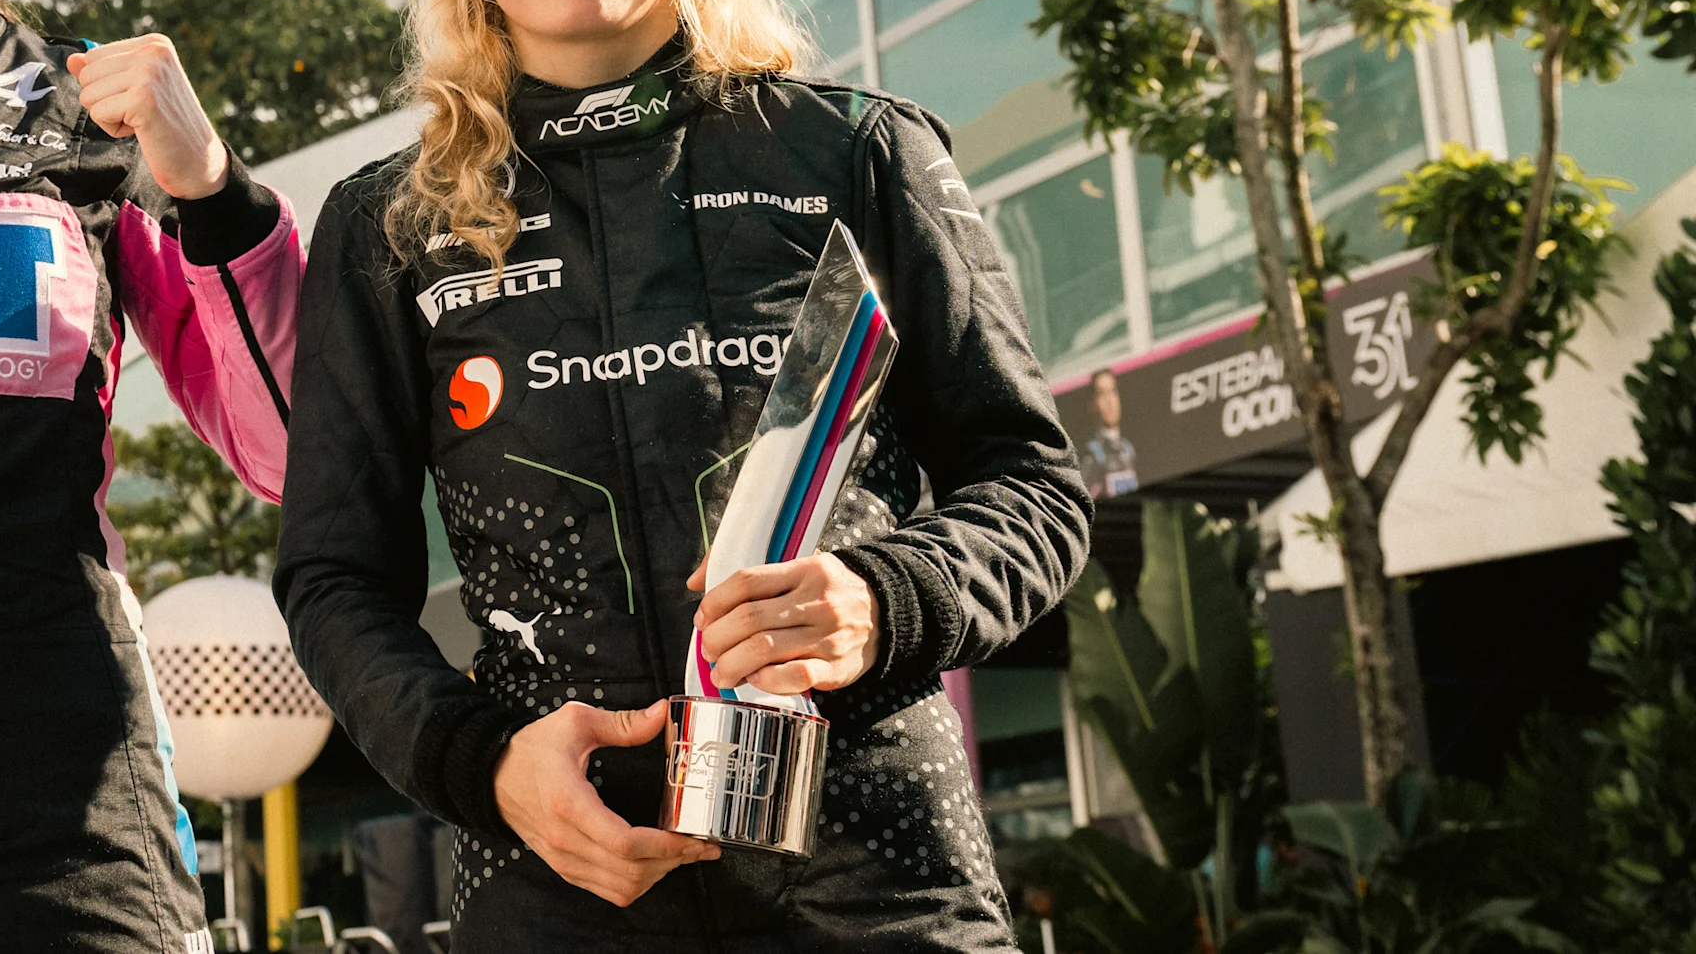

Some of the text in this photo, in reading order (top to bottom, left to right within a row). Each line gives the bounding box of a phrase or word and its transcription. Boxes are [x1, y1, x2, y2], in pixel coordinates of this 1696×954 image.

[538, 89, 673, 141] ACADEMY
[693, 191, 829, 215] IRON DAMES
